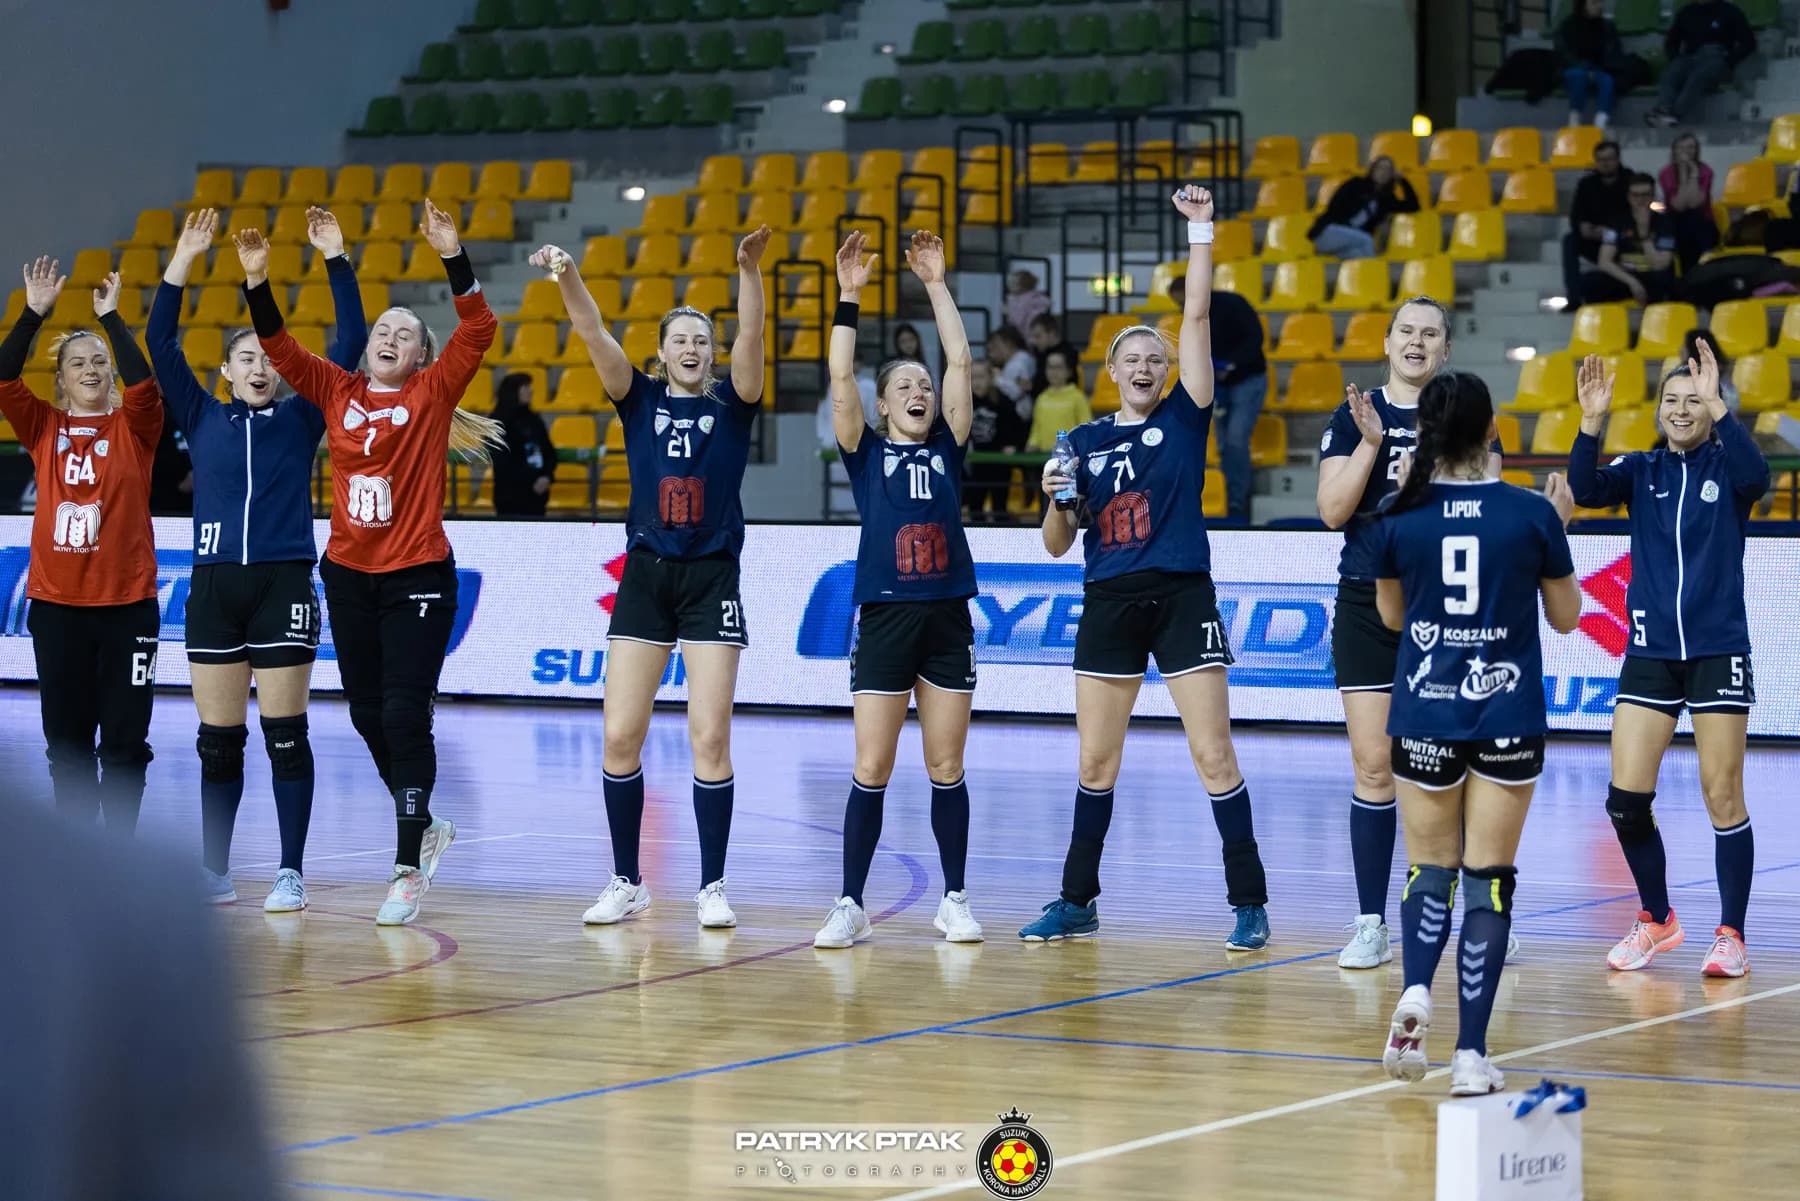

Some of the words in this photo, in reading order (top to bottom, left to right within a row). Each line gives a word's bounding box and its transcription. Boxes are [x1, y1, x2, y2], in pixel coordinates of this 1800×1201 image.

[364, 427, 377, 456] 7
[667, 428, 692, 458] 21
[65, 452, 96, 485] 64
[906, 463, 933, 499] 10
[1112, 455, 1136, 494] 71
[1443, 500, 1482, 518] LIPOK
[198, 522, 221, 555] 91
[1442, 536, 1479, 615] 9
[291, 604, 310, 630] 91
[419, 602, 428, 617] 7
[722, 601, 740, 627] 21
[1201, 621, 1222, 650] 71
[1443, 627, 1507, 641] KOSZALIN
[1632, 610, 1647, 646] 5
[1471, 669, 1509, 692] LOTTO
[1731, 657, 1744, 687] 5
[1401, 737, 1456, 758] UNITRAL
[1409, 751, 1441, 766] HOTEL
[1500, 1151, 1566, 1181] Lirene
